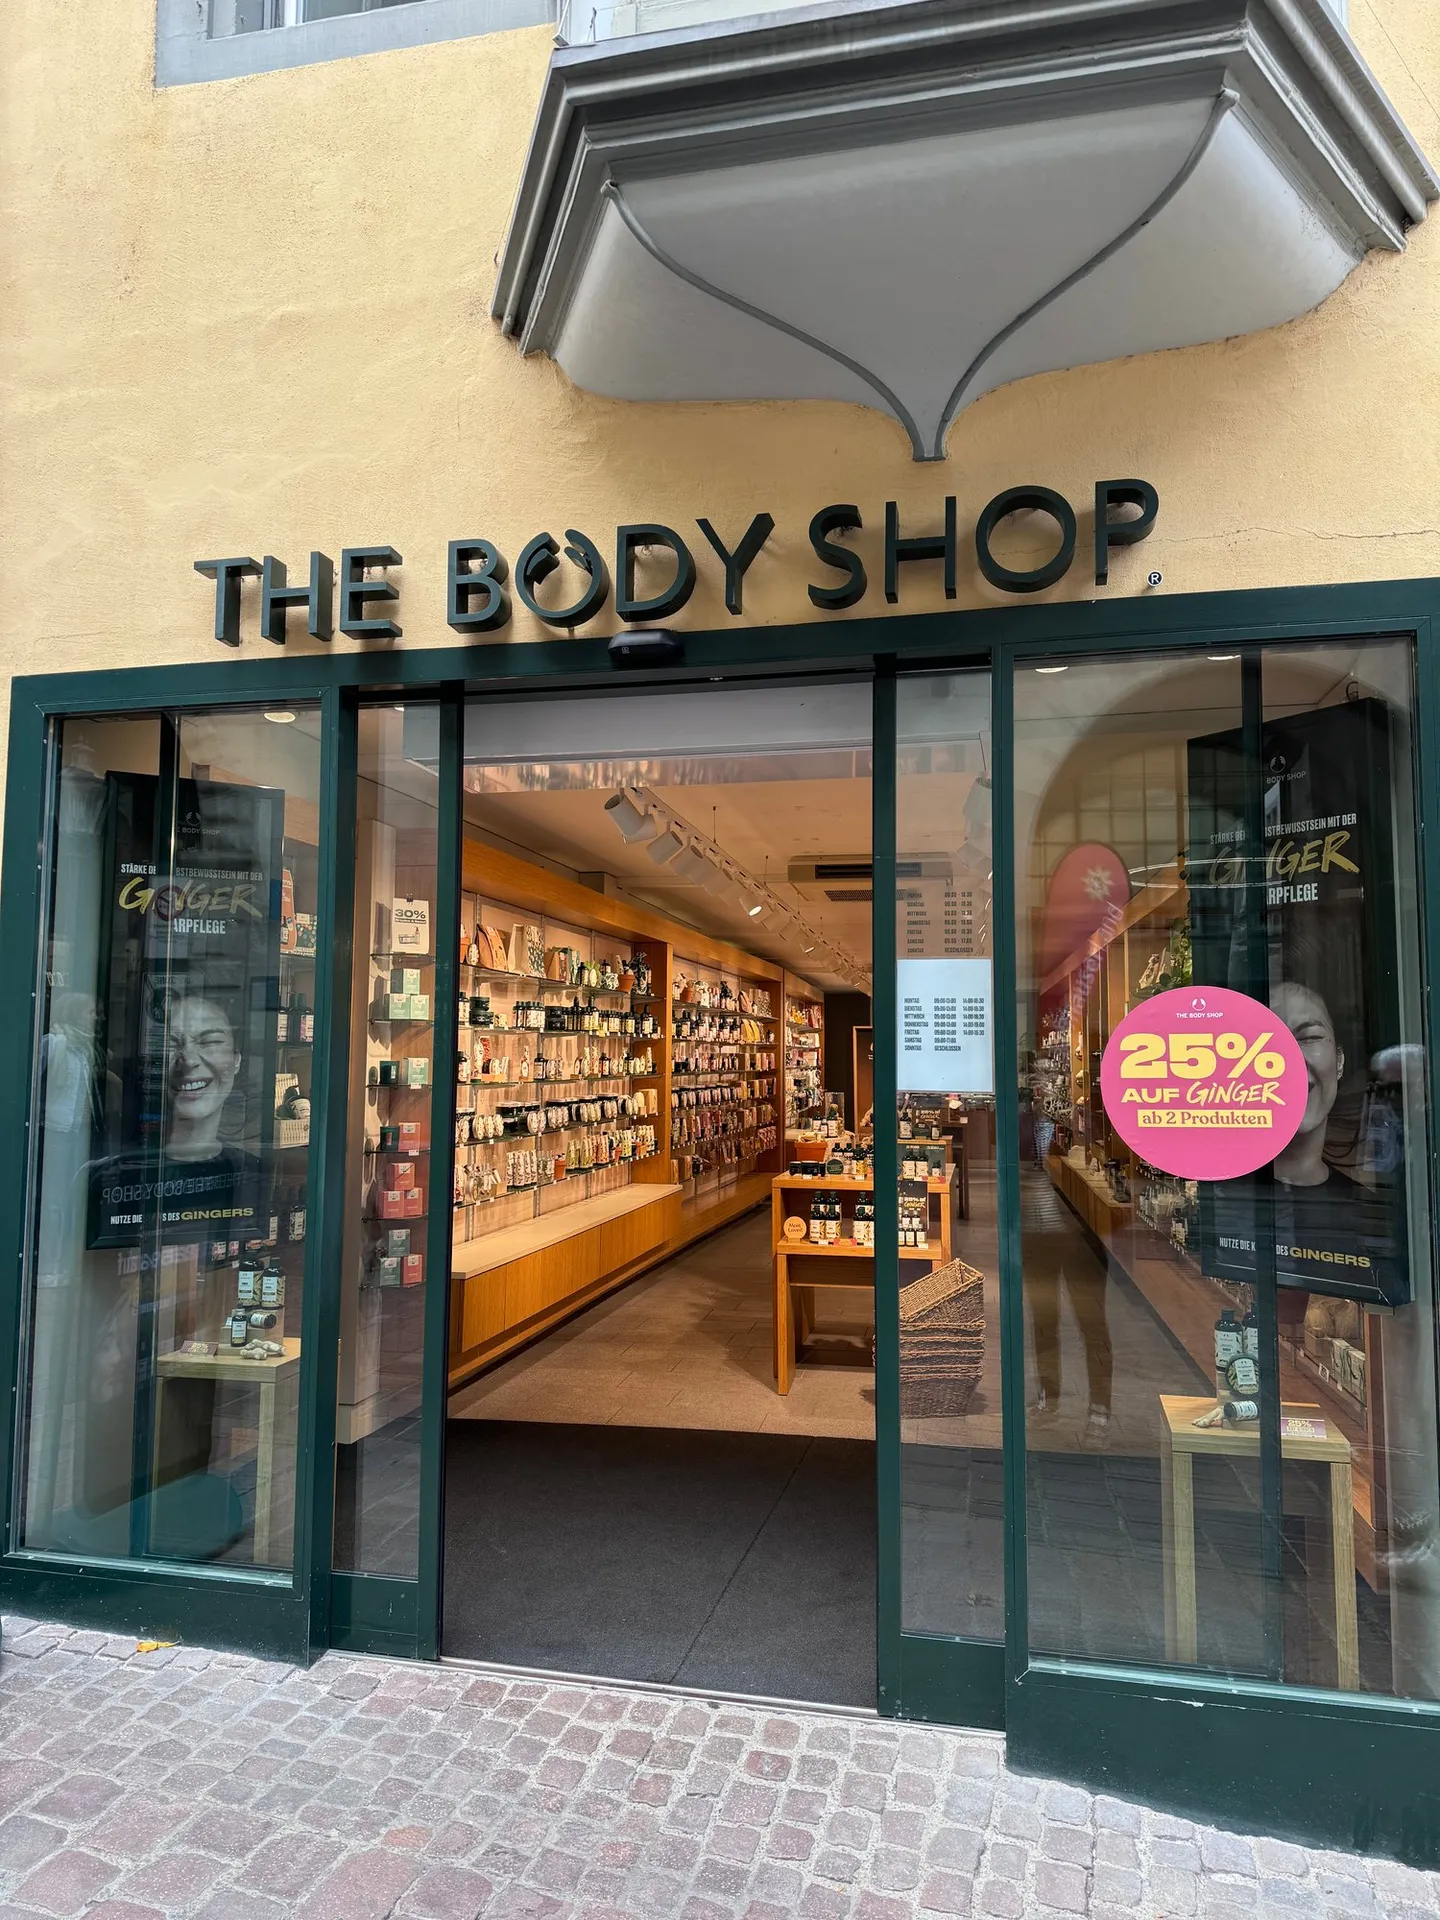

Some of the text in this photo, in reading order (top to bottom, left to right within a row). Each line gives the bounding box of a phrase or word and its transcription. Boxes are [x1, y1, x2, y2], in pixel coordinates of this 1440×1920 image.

[194, 545, 403, 647] THE
[447, 511, 776, 634] BODY
[807, 478, 1160, 610] SHOP
[1266, 771, 1306, 784] BODY SHOP
[1210, 830, 1235, 845] STÄRKE
[1327, 815, 1341, 828] MIT
[1342, 813, 1357, 826] DER
[121, 863, 147, 874] STÄRKE
[237, 871, 249, 880] MIT
[250, 872, 263, 881] DER
[395, 908, 426, 919] 30%
[1120, 1032, 1286, 1079] 25%
[1121, 1088, 1180, 1104] AUF
[1142, 1112, 1268, 1125] ab 2 Produkten
[110, 1214, 131, 1225] NUTZE
[132, 1214, 142, 1223] DIE
[168, 1210, 180, 1221] DES
[181, 1208, 254, 1221] GINGERS
[1219, 1237, 1239, 1250] NUTZE
[1240, 1239, 1250, 1250] DIE
[1276, 1244, 1288, 1256] DES
[1289, 1247, 1370, 1268] GINGERS
